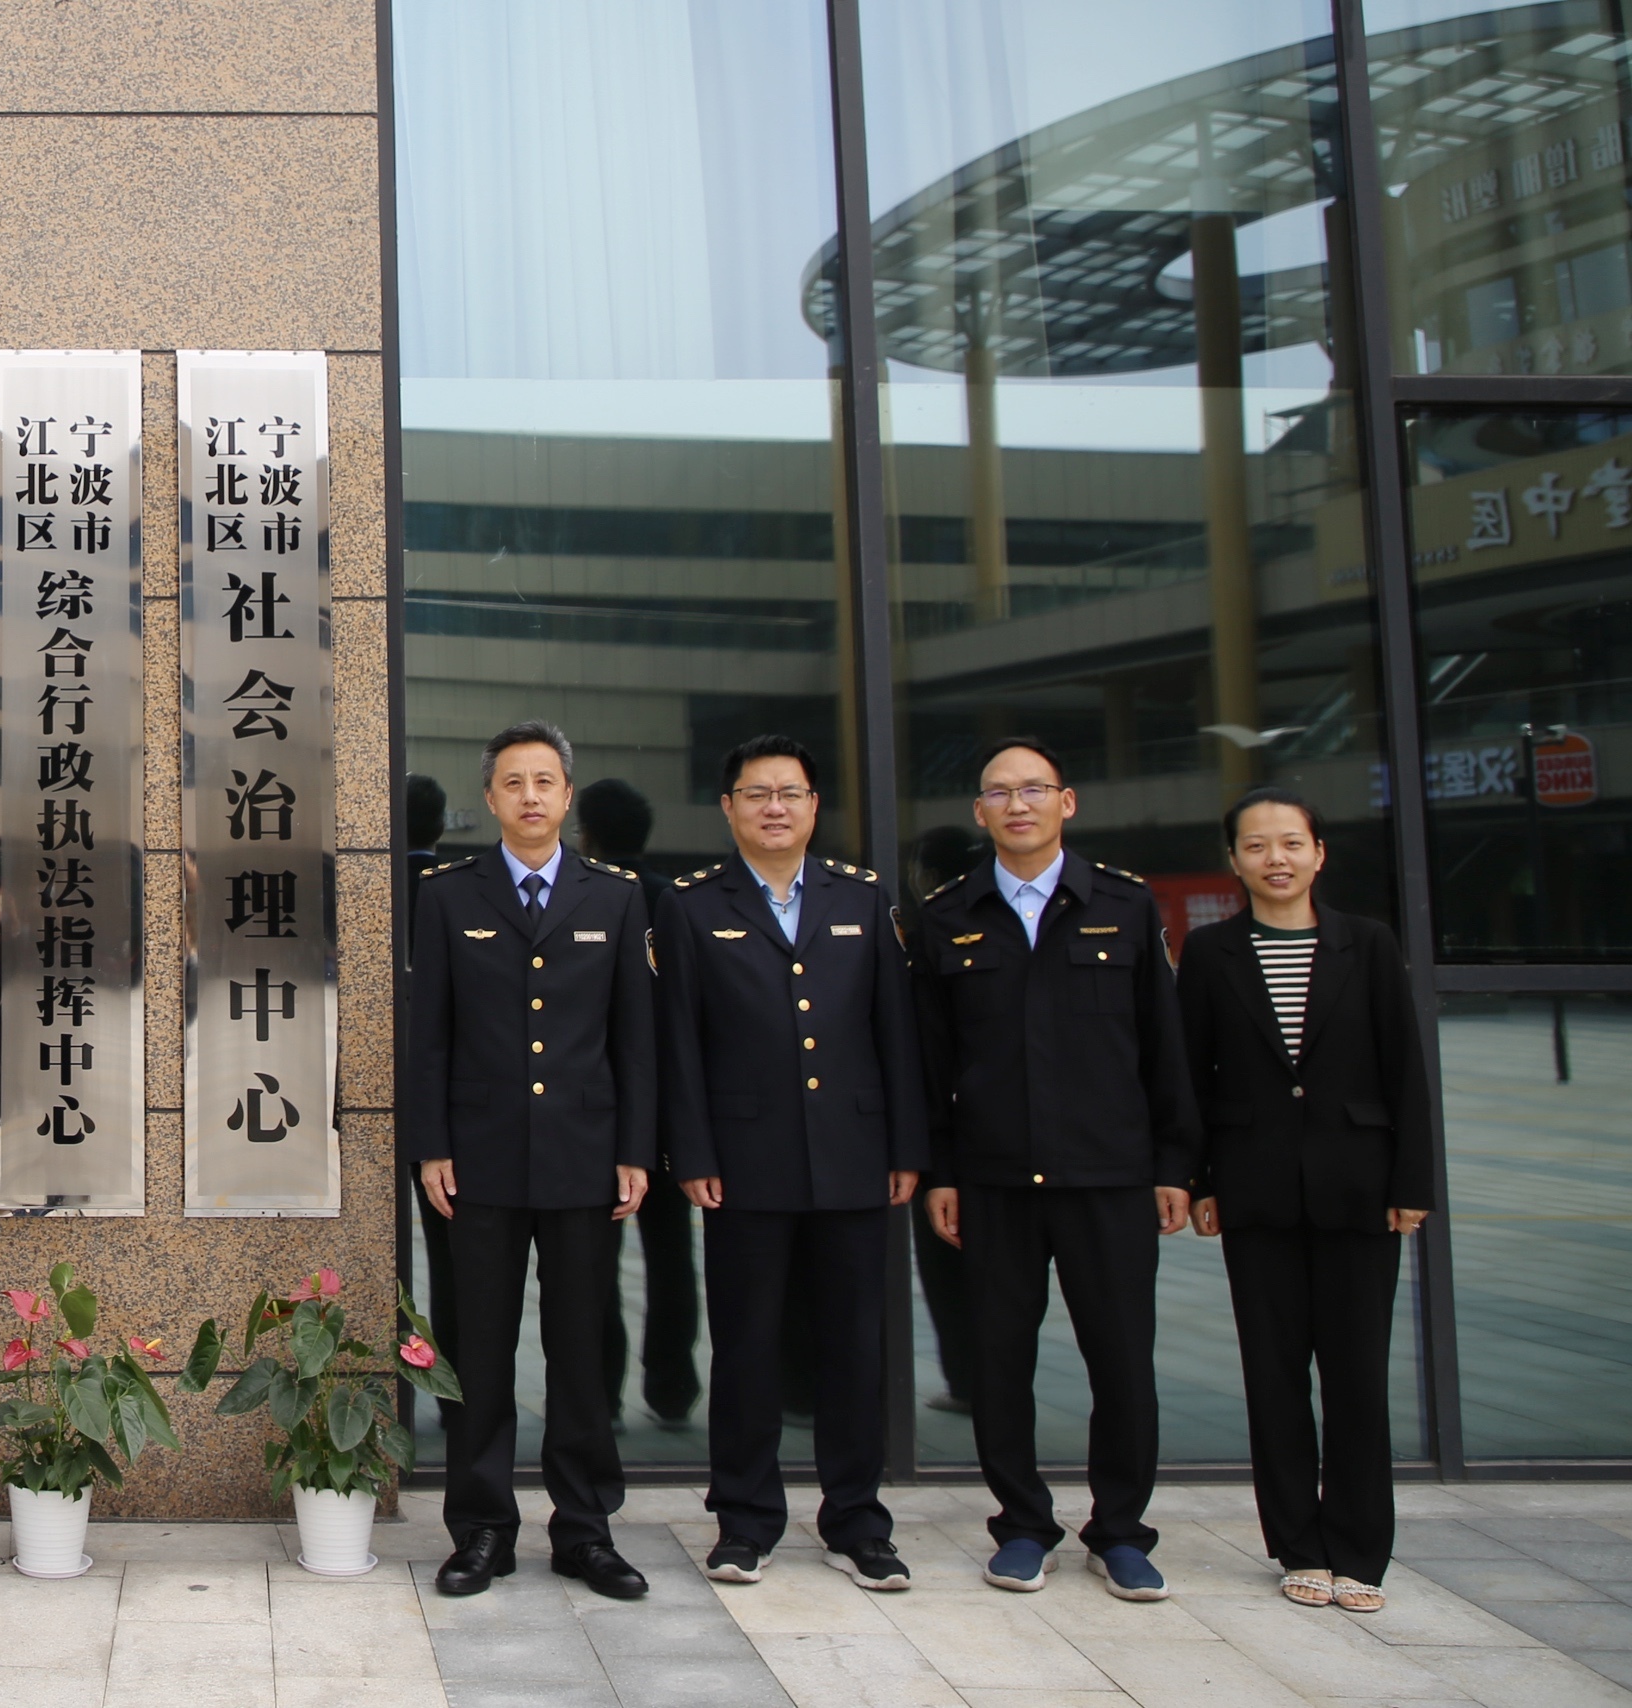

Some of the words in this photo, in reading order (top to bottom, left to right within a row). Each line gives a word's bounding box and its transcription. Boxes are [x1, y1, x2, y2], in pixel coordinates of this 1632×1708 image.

[15, 416, 59, 552] 江北区
[70, 416, 113, 554] 宁波市
[205, 416, 249, 553] 江北区
[258, 416, 303, 554] 宁波市
[35, 569, 96, 1145] 综合行政执法指挥中心
[221, 571, 300, 1143] 社会治理中心
